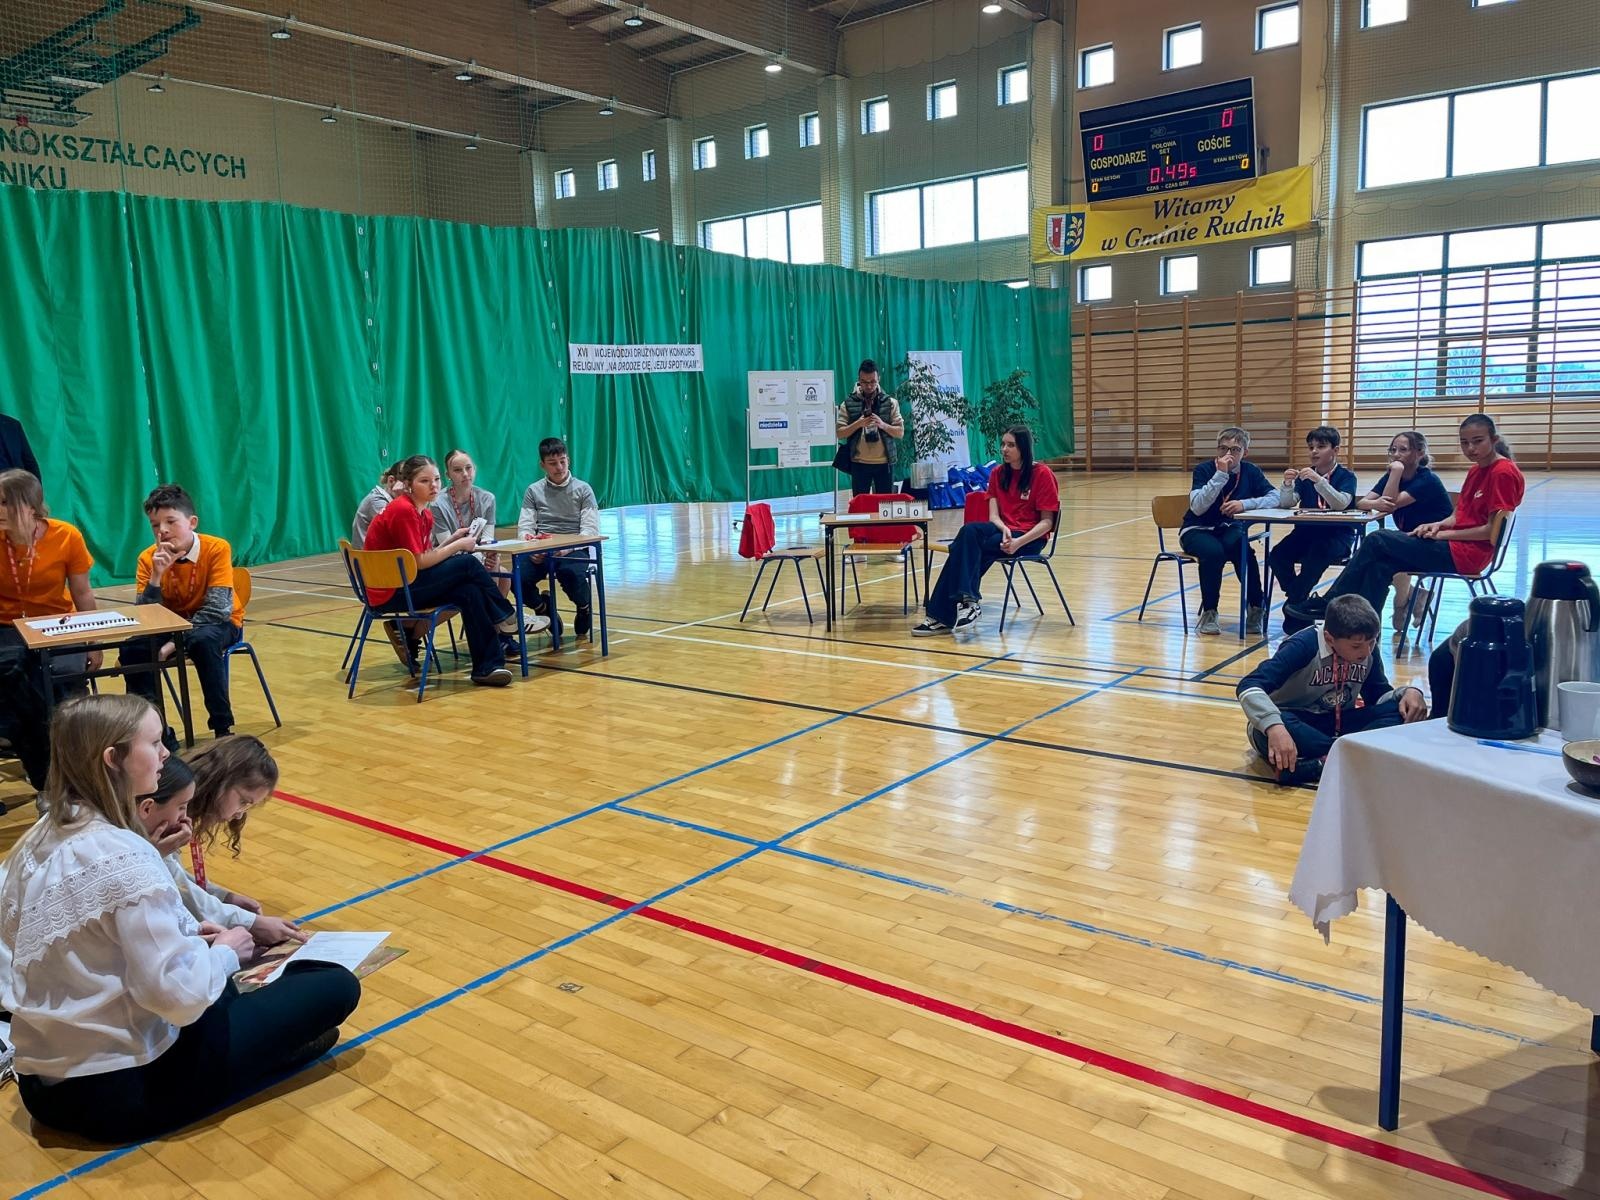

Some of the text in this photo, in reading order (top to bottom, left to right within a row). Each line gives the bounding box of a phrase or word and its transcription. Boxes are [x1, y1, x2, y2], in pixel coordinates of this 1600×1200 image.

[1221, 109, 1234, 128] 0
[1093, 134, 1104, 151] 0
[1197, 135, 1232, 152] GOŚCIE
[1090, 150, 1147, 170] GOSPODARZE
[1241, 158, 1249, 169] 0
[0, 160, 67, 190] NIKU
[1091, 182, 1099, 193] 0
[1146, 184, 1159, 192] CZAS
[1153, 194, 1236, 220] Witamy
[1101, 204, 1286, 251] w Gminie Rudnik
[669, 347, 695, 357] KONKURS
[882, 507, 919, 518] 0 0 0
